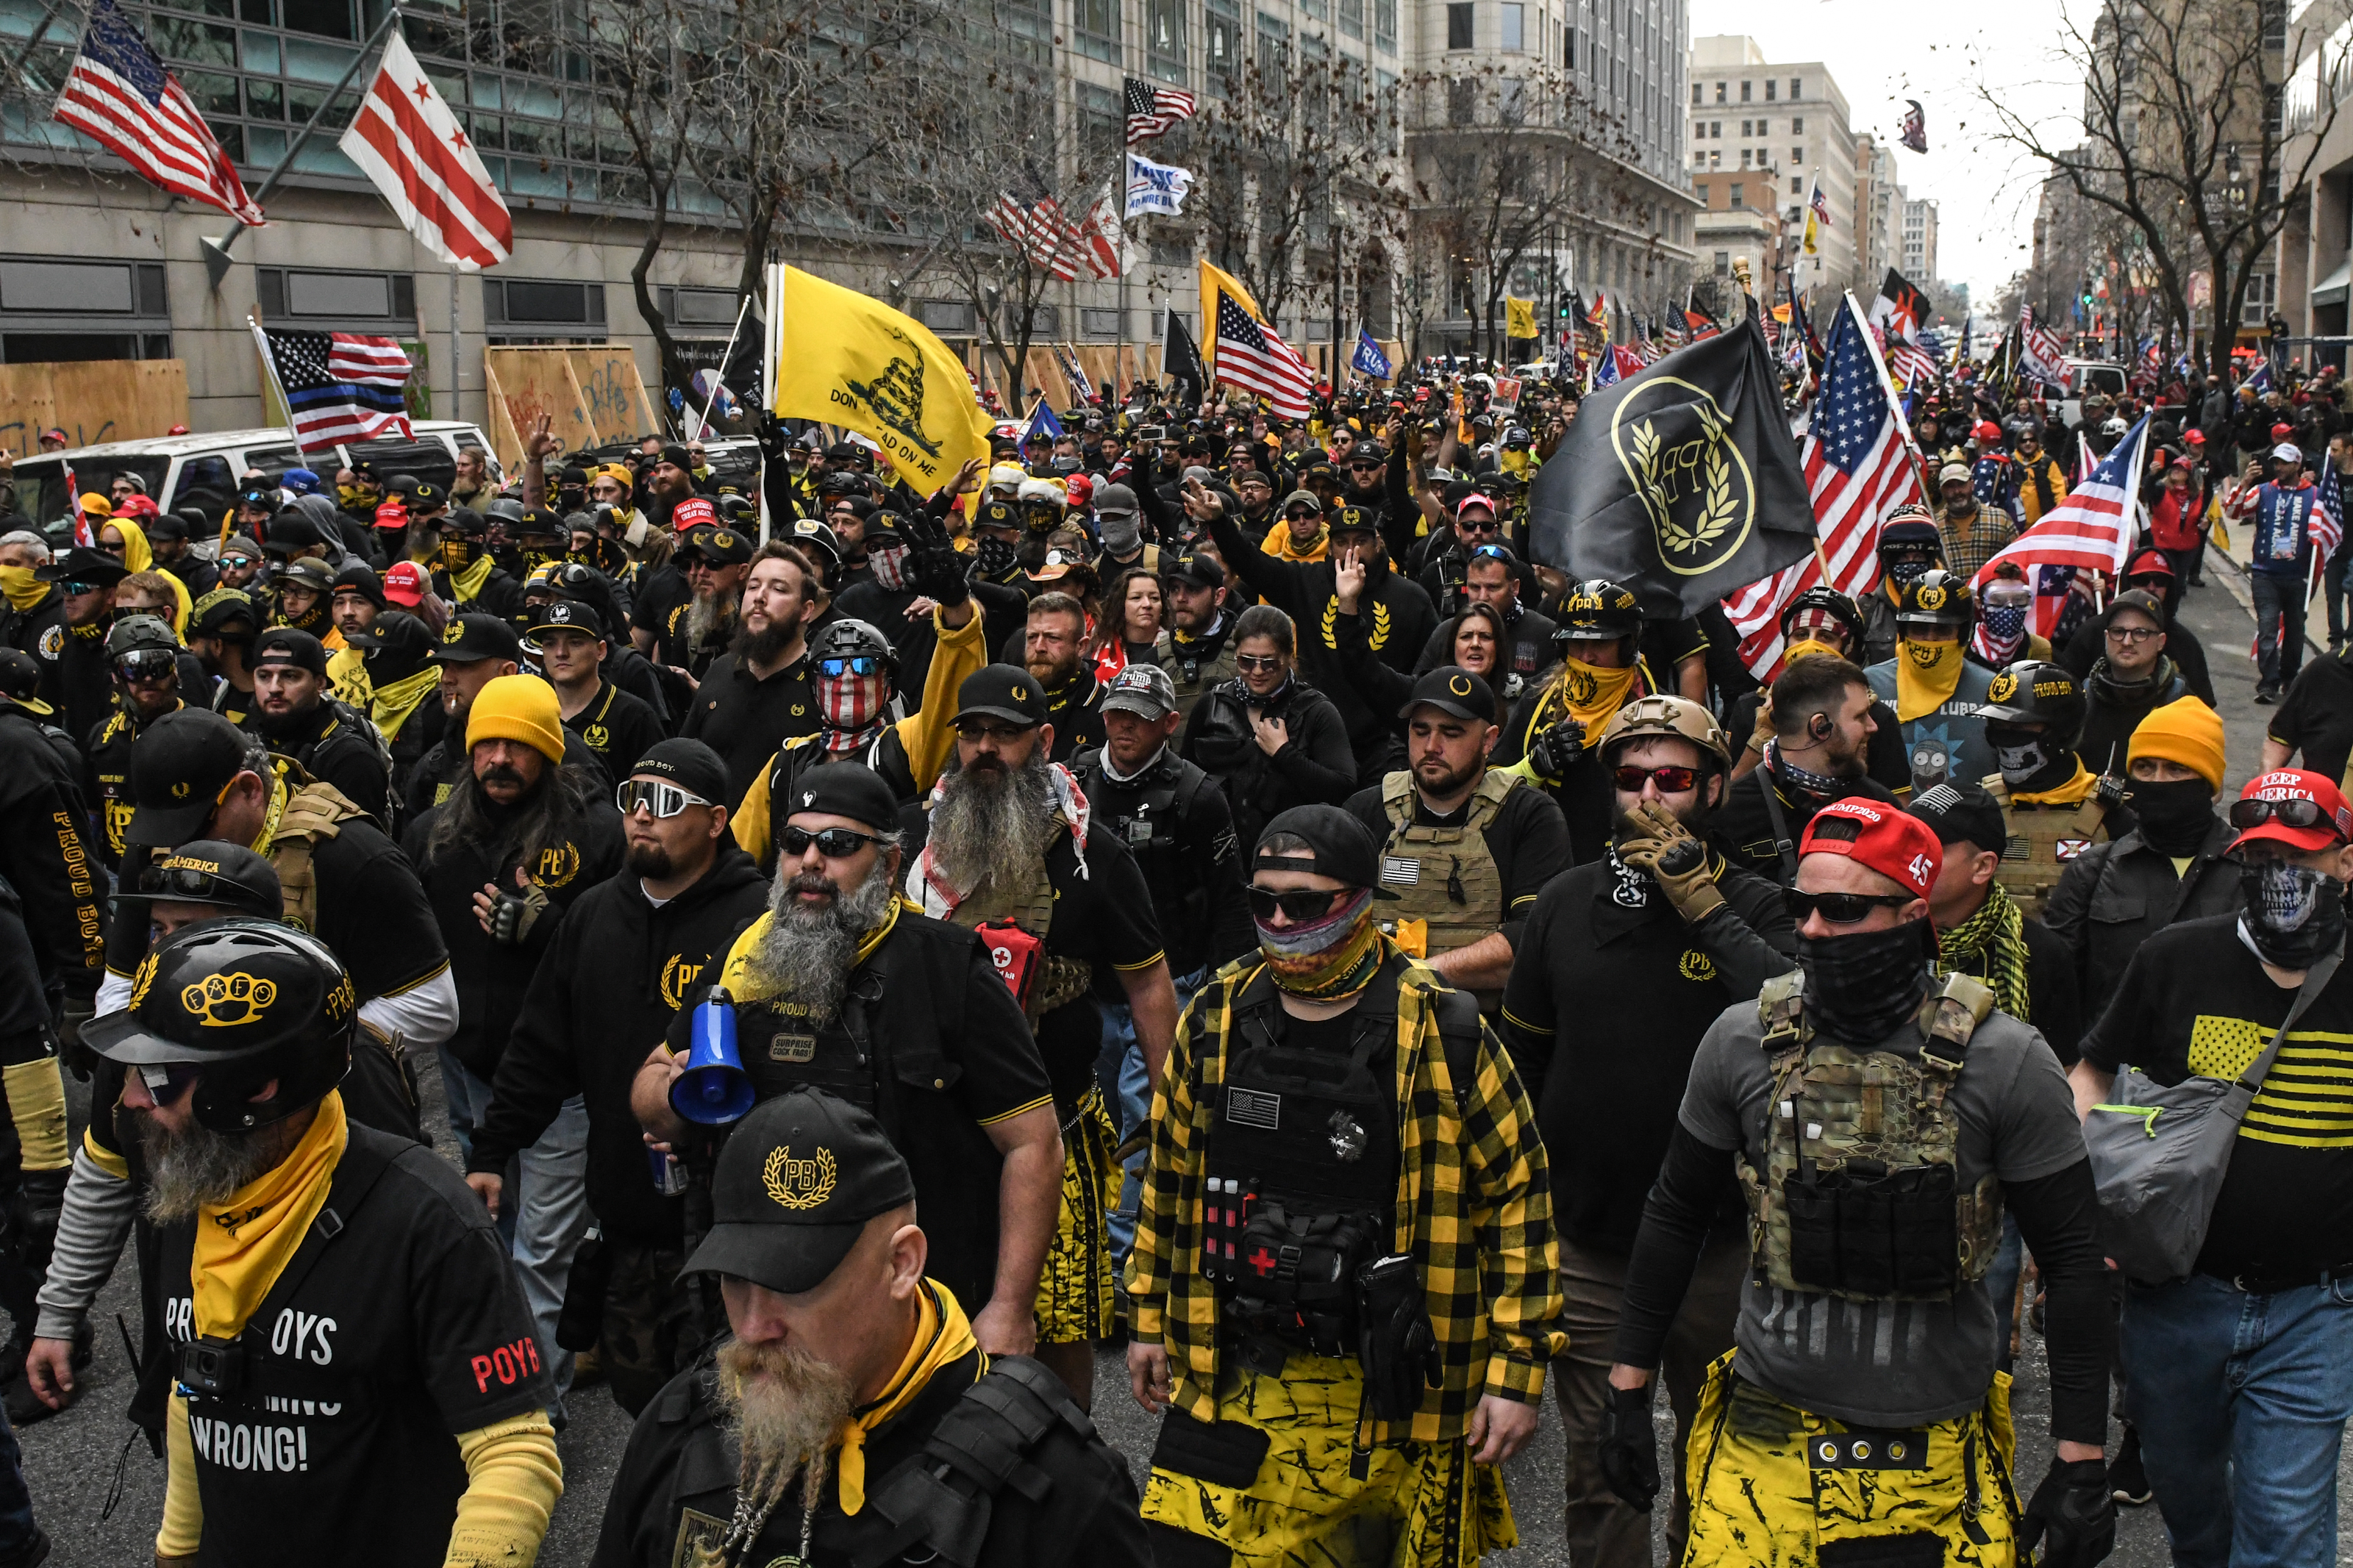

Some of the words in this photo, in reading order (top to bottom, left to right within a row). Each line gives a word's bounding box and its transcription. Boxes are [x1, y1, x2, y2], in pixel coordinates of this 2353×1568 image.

[2032, 332, 2075, 378] TRUMP
[1188, 436, 1196, 445] P
[899, 445, 918, 464] ON
[916, 459, 938, 478] ME
[676, 504, 692, 515] MAKE
[691, 501, 713, 512] AMERICA
[681, 511, 698, 521] GREAT
[697, 509, 712, 518] AGAIN
[2291, 495, 2303, 522] MAKE
[1924, 590, 1939, 603] PB
[1120, 670, 1151, 687] Trump
[1993, 678, 2009, 693] PB
[2260, 772, 2302, 789] KEEP
[113, 805, 135, 837] P
[1935, 809, 1945, 817] ME
[54, 811, 93, 898] PROUD
[539, 848, 565, 876] PB
[171, 856, 220, 873] AMERICA
[1908, 853, 1934, 887] 45
[77, 904, 104, 969] BOYS
[1004, 971, 1015, 980] kit
[185, 978, 272, 1012] FAFO
[772, 1000, 807, 1017] PROUD
[772, 1047, 792, 1056] COCK
[792, 1048, 812, 1058] FAGS!
[775, 1038, 814, 1050] SURPRISE
[784, 1159, 816, 1191] PB
[271, 1308, 338, 1366] OYS
[190, 1414, 308, 1472] WRONG!
